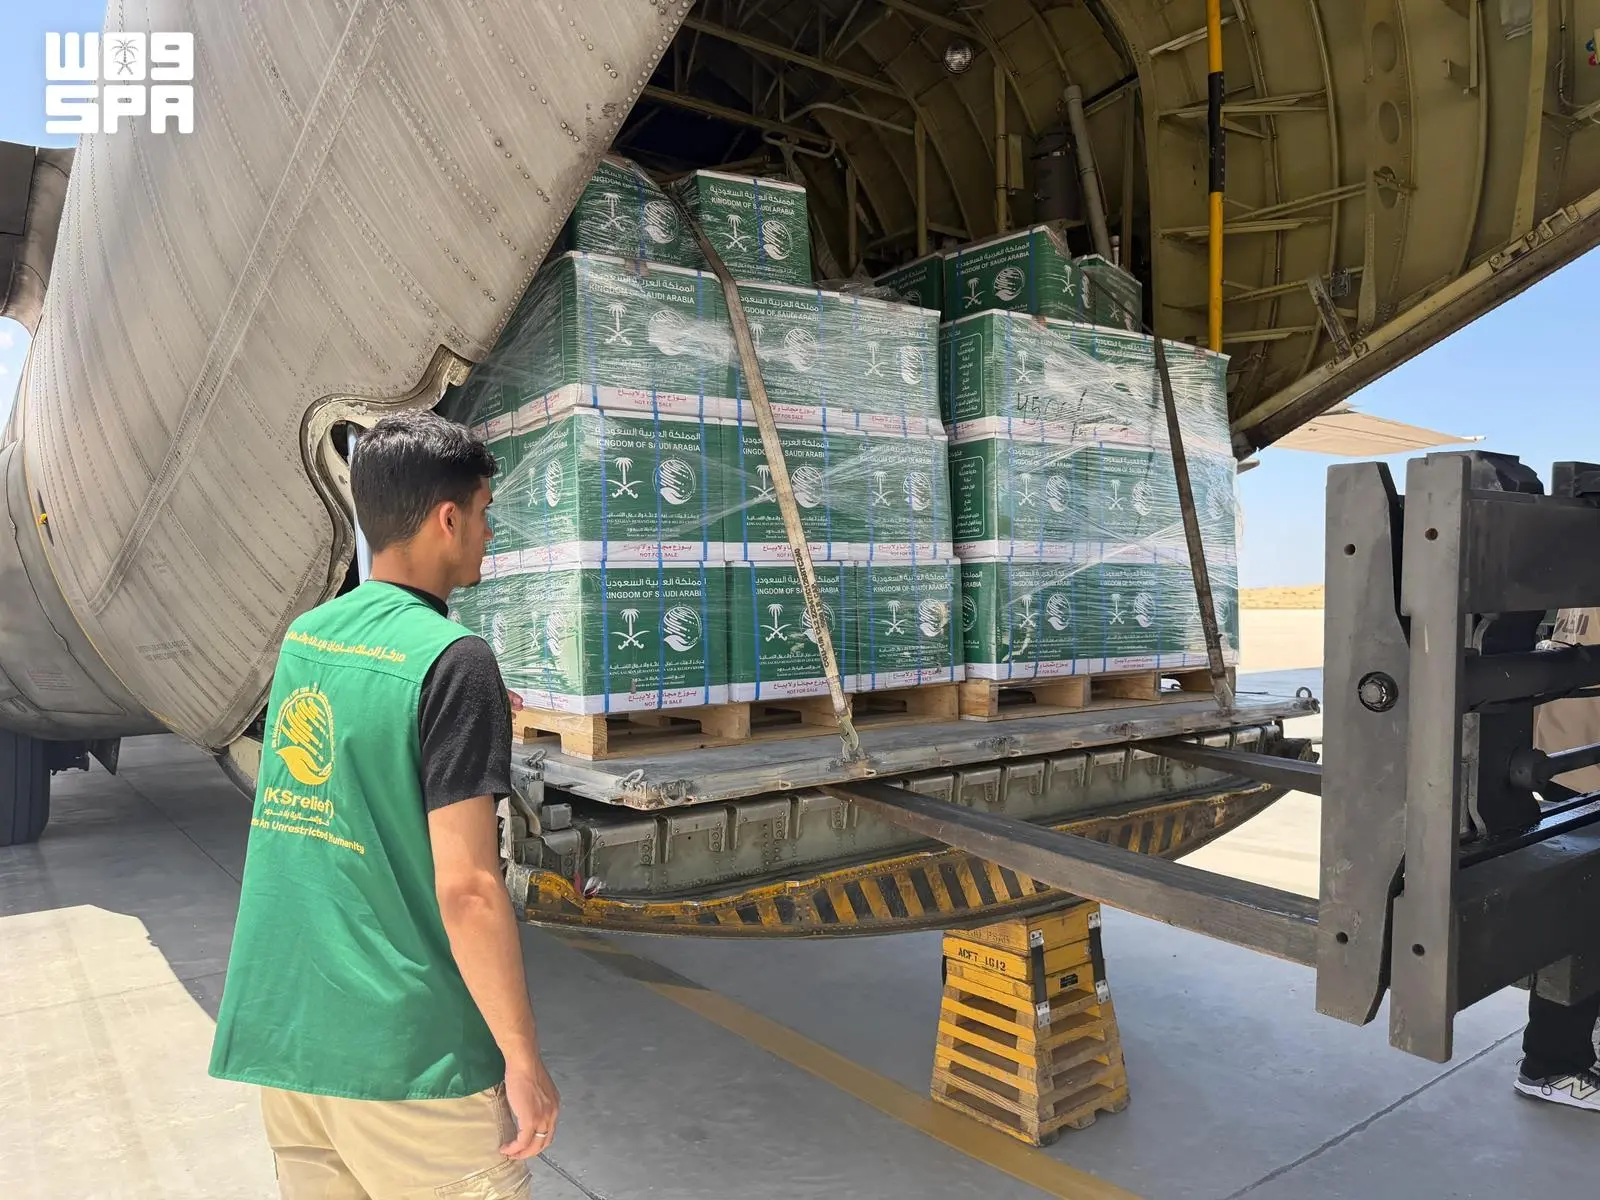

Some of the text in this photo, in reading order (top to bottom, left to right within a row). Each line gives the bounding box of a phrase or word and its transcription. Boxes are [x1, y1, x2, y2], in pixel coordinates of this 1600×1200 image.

[744, 191, 768, 202] العبية
[711, 196, 795, 216] KINGDOM OF SUDI ARABIA
[1007, 250, 1030, 261] ARABIA
[662, 280, 695, 293] المملكة
[666, 294, 695, 305] ARABIA
[740, 295, 767, 305] السعود
[669, 429, 700, 441] المملكة
[596, 438, 634, 448] KNGDOM
[635, 441, 646, 449] OF
[672, 443, 701, 452] ARABIA
[784, 449, 803, 458] SAUDI
[804, 450, 826, 458] ARABI
[605, 577, 707, 589] امملكة العبية السعودي
[755, 575, 787, 585] السعودي
[816, 575, 839, 584] المملك
[642, 590, 654, 598] OF
[654, 590, 678, 598] SUDI
[679, 589, 707, 597] ARABI
[263, 786, 335, 820] (KSrelief)
[271, 820, 328, 840] Unrestricted
[328, 831, 365, 855] Humanity
